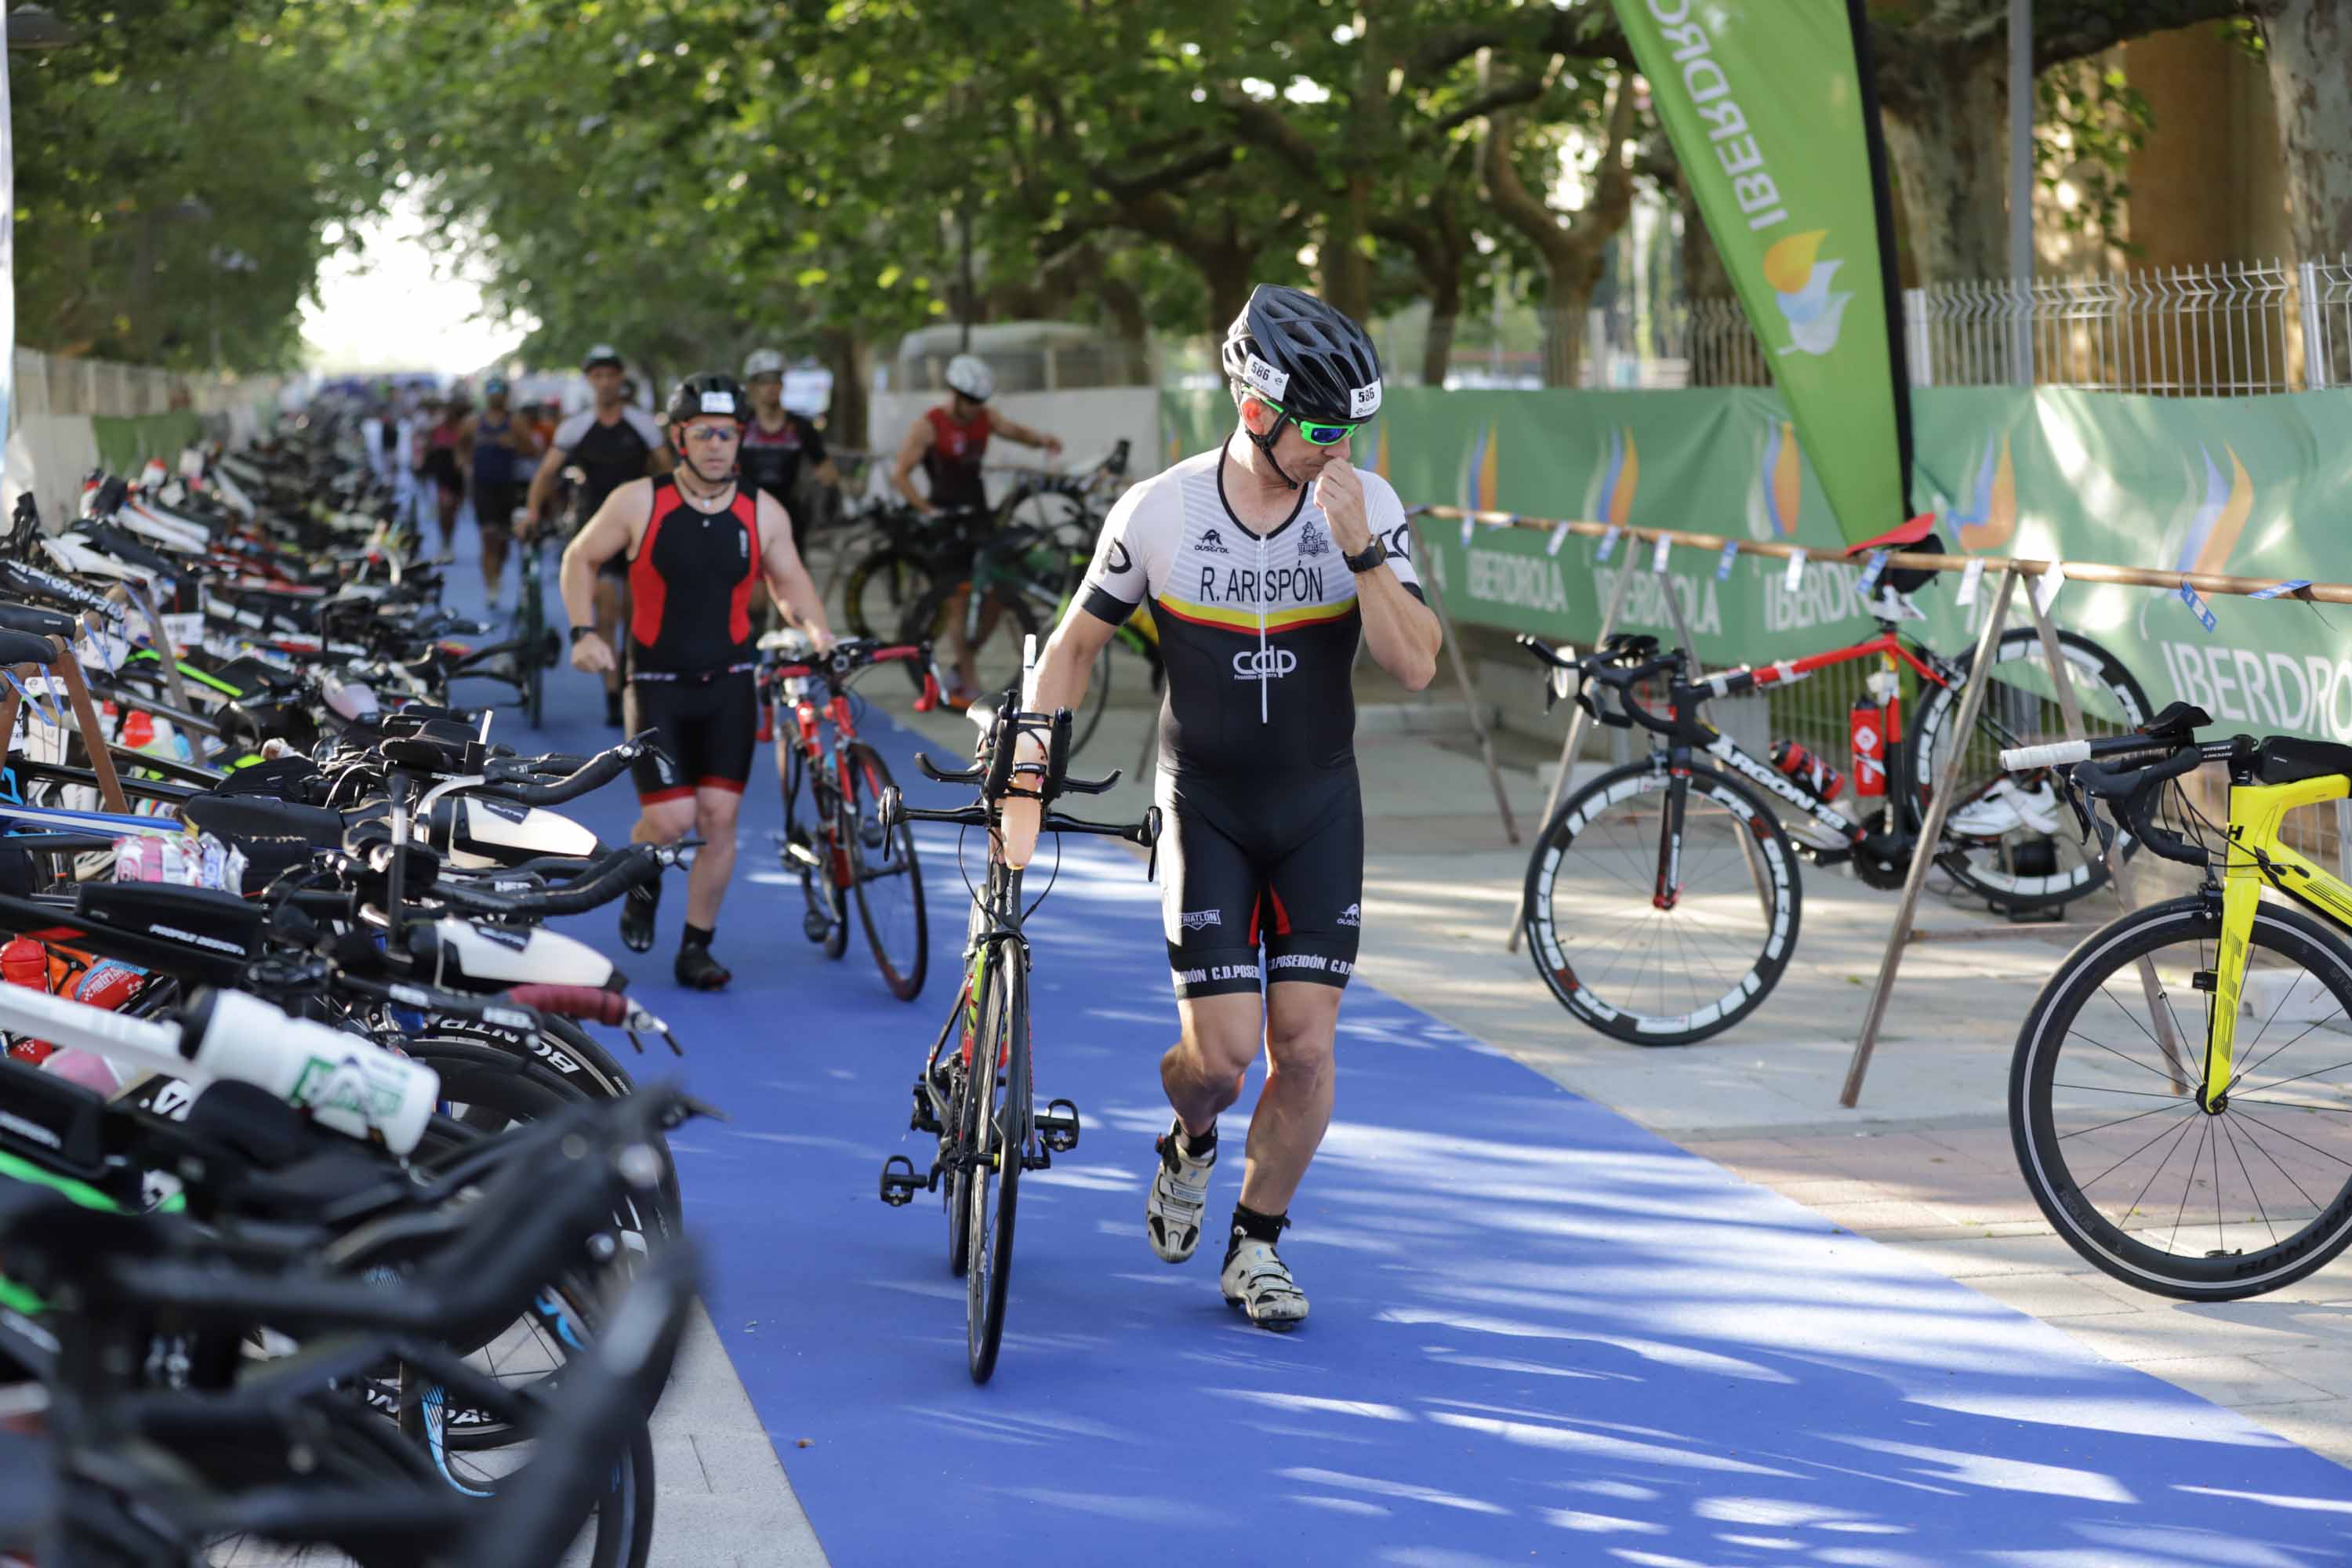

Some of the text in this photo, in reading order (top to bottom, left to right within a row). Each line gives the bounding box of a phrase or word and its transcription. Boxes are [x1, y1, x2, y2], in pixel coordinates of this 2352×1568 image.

[1250, 361, 1270, 380] 586
[1358, 387, 1375, 402] 586
[1200, 559, 1323, 602] R. ARISPÓN
[1467, 548, 1569, 614] IBERDROLA
[1707, 733, 1817, 811] ARGON
[1815, 803, 1848, 830] 18
